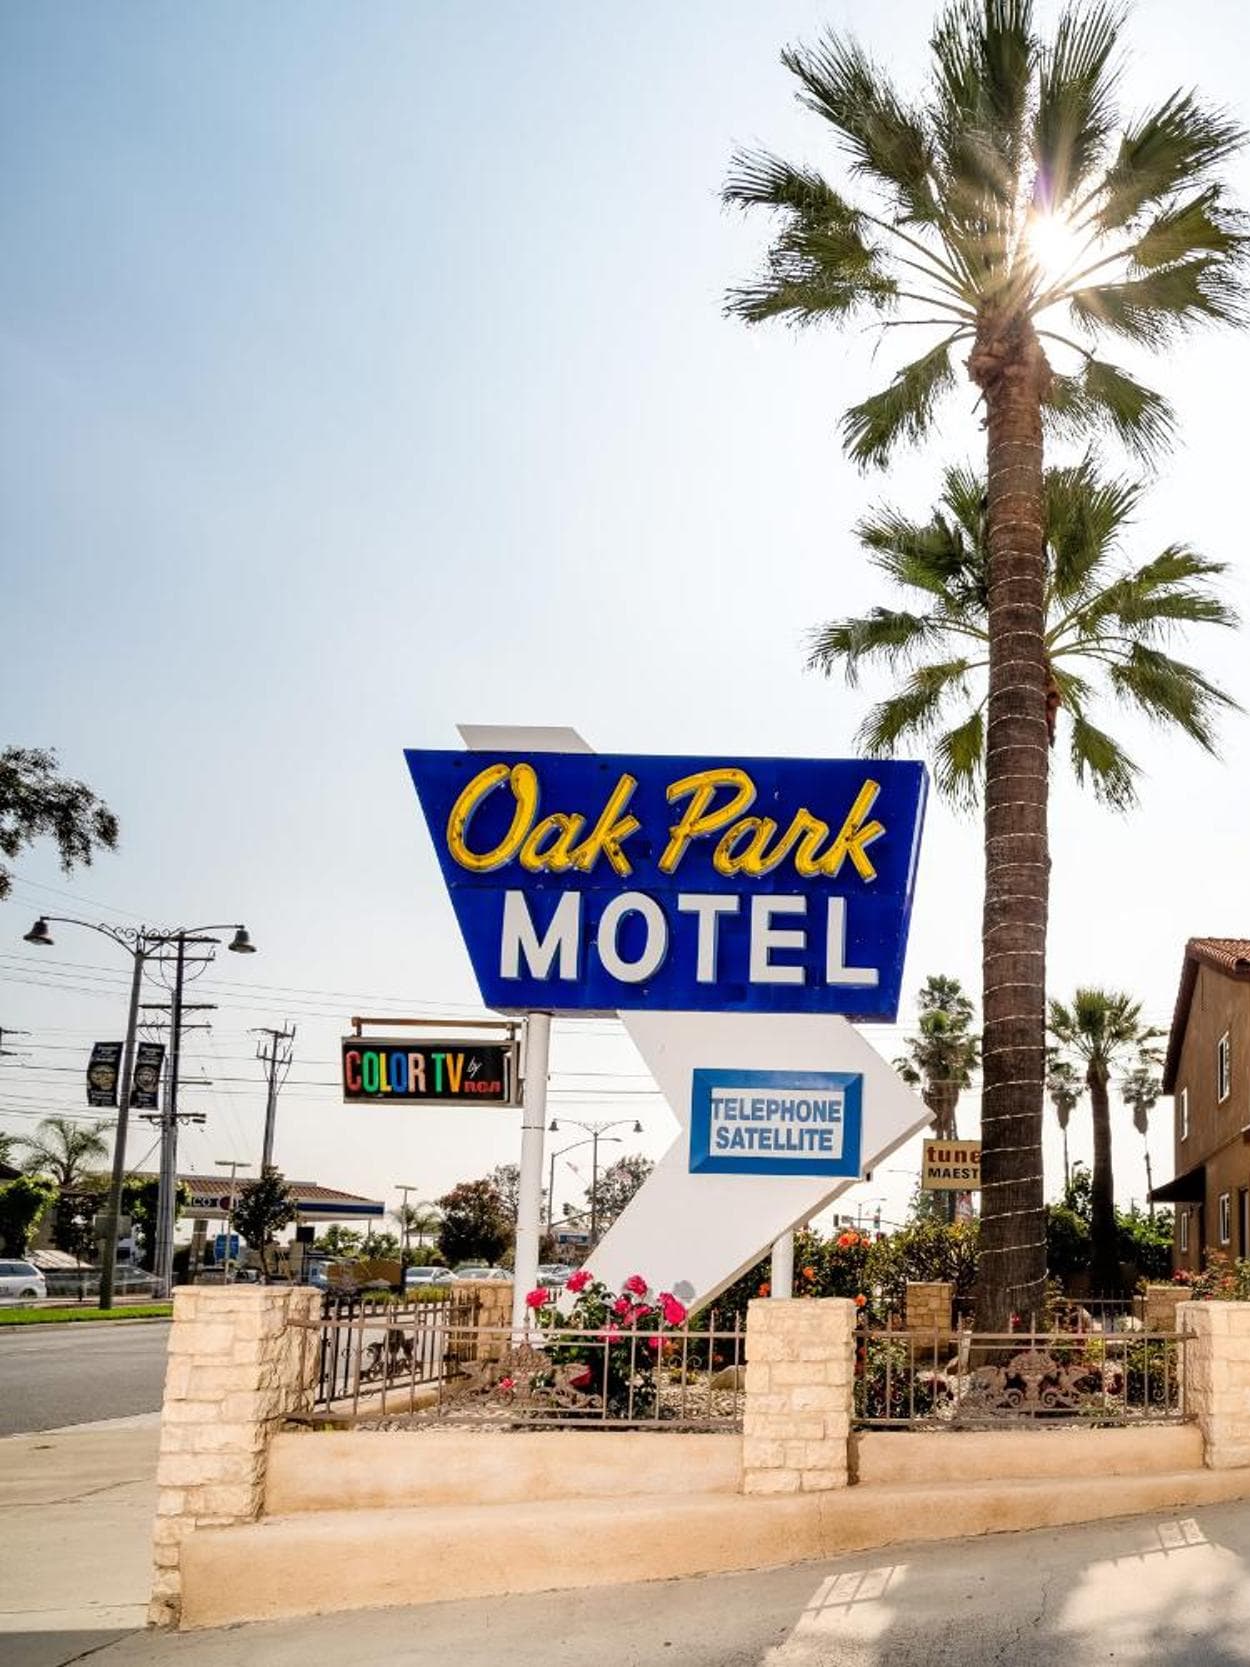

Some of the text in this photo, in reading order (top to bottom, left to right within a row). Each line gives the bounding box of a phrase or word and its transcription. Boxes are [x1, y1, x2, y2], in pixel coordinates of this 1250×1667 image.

[446, 763, 887, 883] Oak Park
[499, 889, 880, 986] MOTEL
[345, 1051, 483, 1093] COLOR TV by
[464, 1081, 501, 1093] RCA
[711, 1097, 842, 1122] TELEPHONE
[715, 1126, 834, 1151] SATELLITE
[928, 1167, 979, 1179] MAEST
